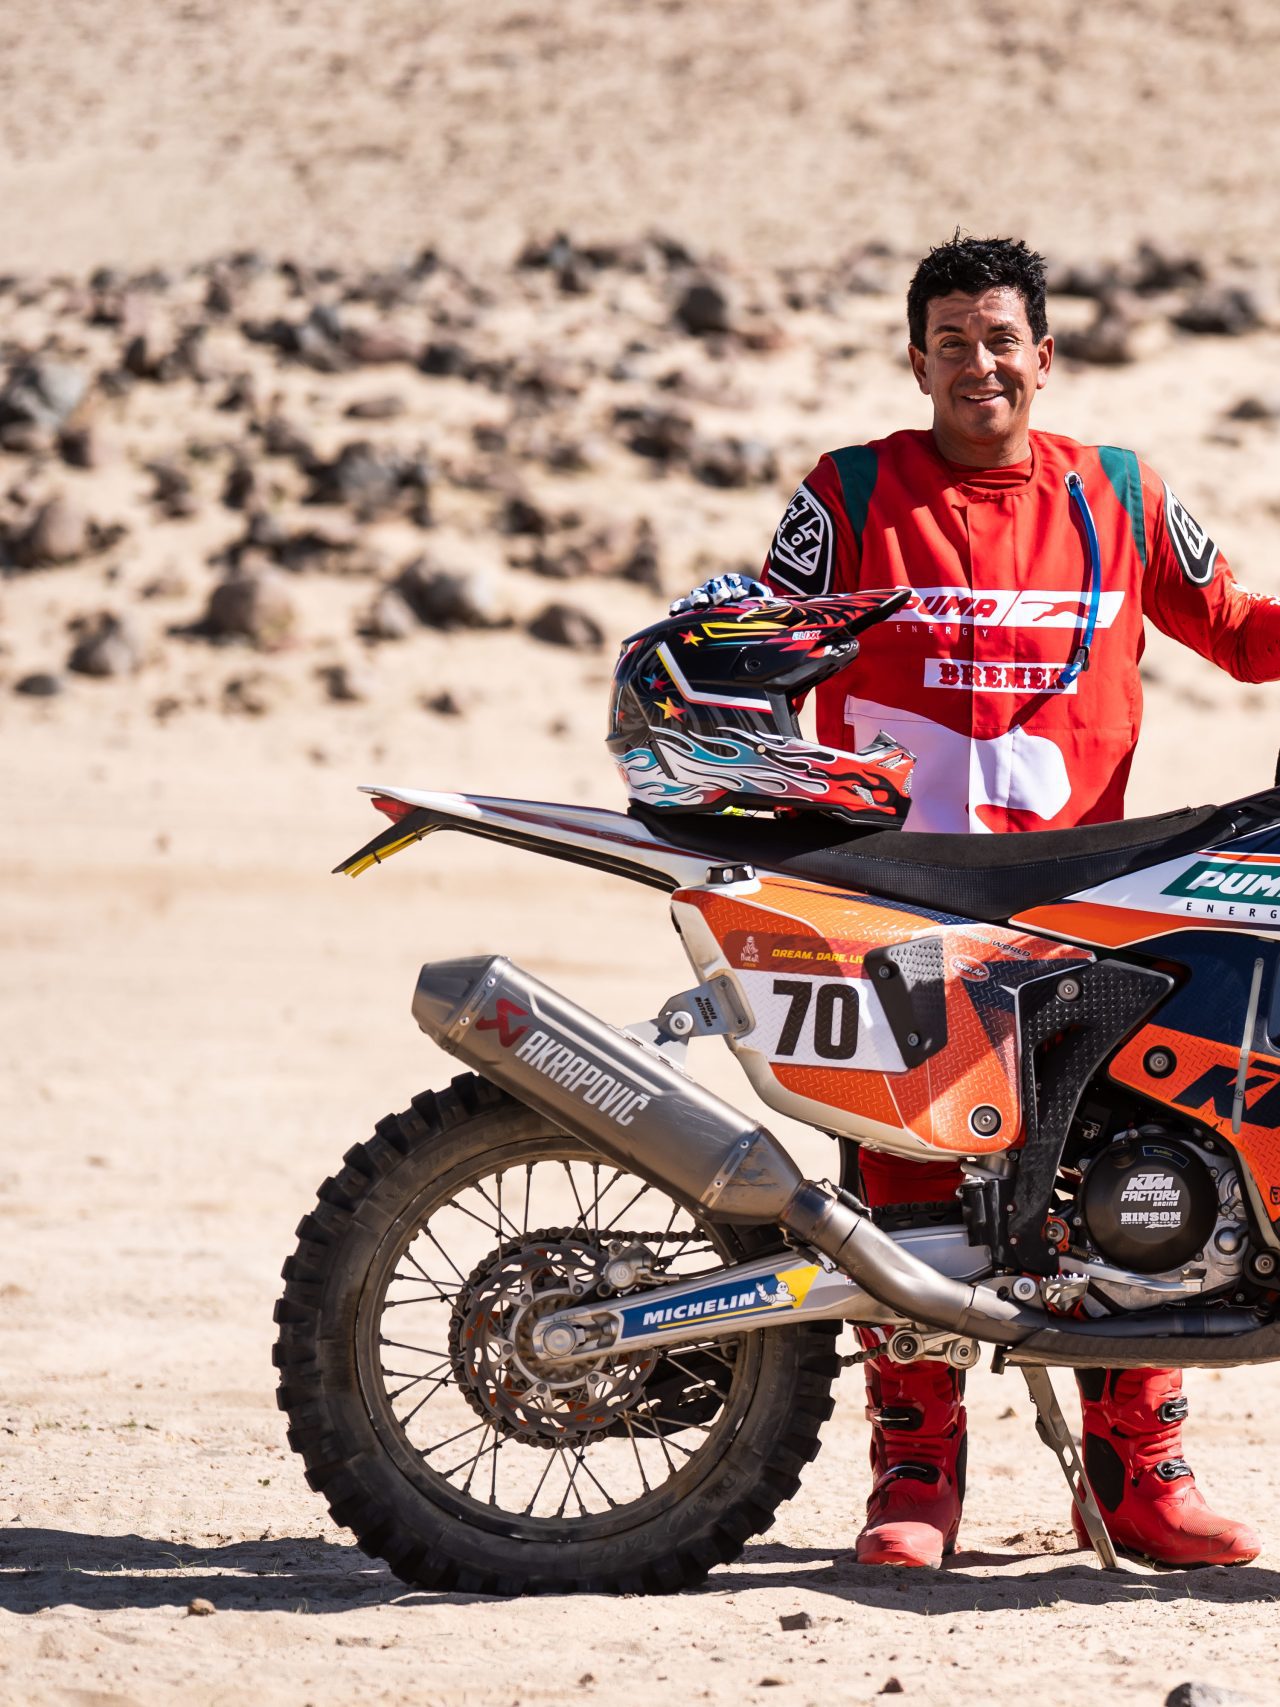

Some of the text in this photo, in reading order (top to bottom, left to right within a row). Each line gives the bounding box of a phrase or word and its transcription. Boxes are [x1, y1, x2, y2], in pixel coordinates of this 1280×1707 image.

[896, 624, 989, 637] ENERGY
[772, 948, 814, 960] DREAM.
[816, 952, 848, 963] DARE.
[992, 940, 1031, 957] WORLD
[773, 979, 860, 1061] 70
[1126, 1173, 1174, 1191] KTM
[1120, 1189, 1181, 1202] FACTORY
[1120, 1211, 1182, 1222] HINSON
[642, 1291, 756, 1327] MICHELIN
